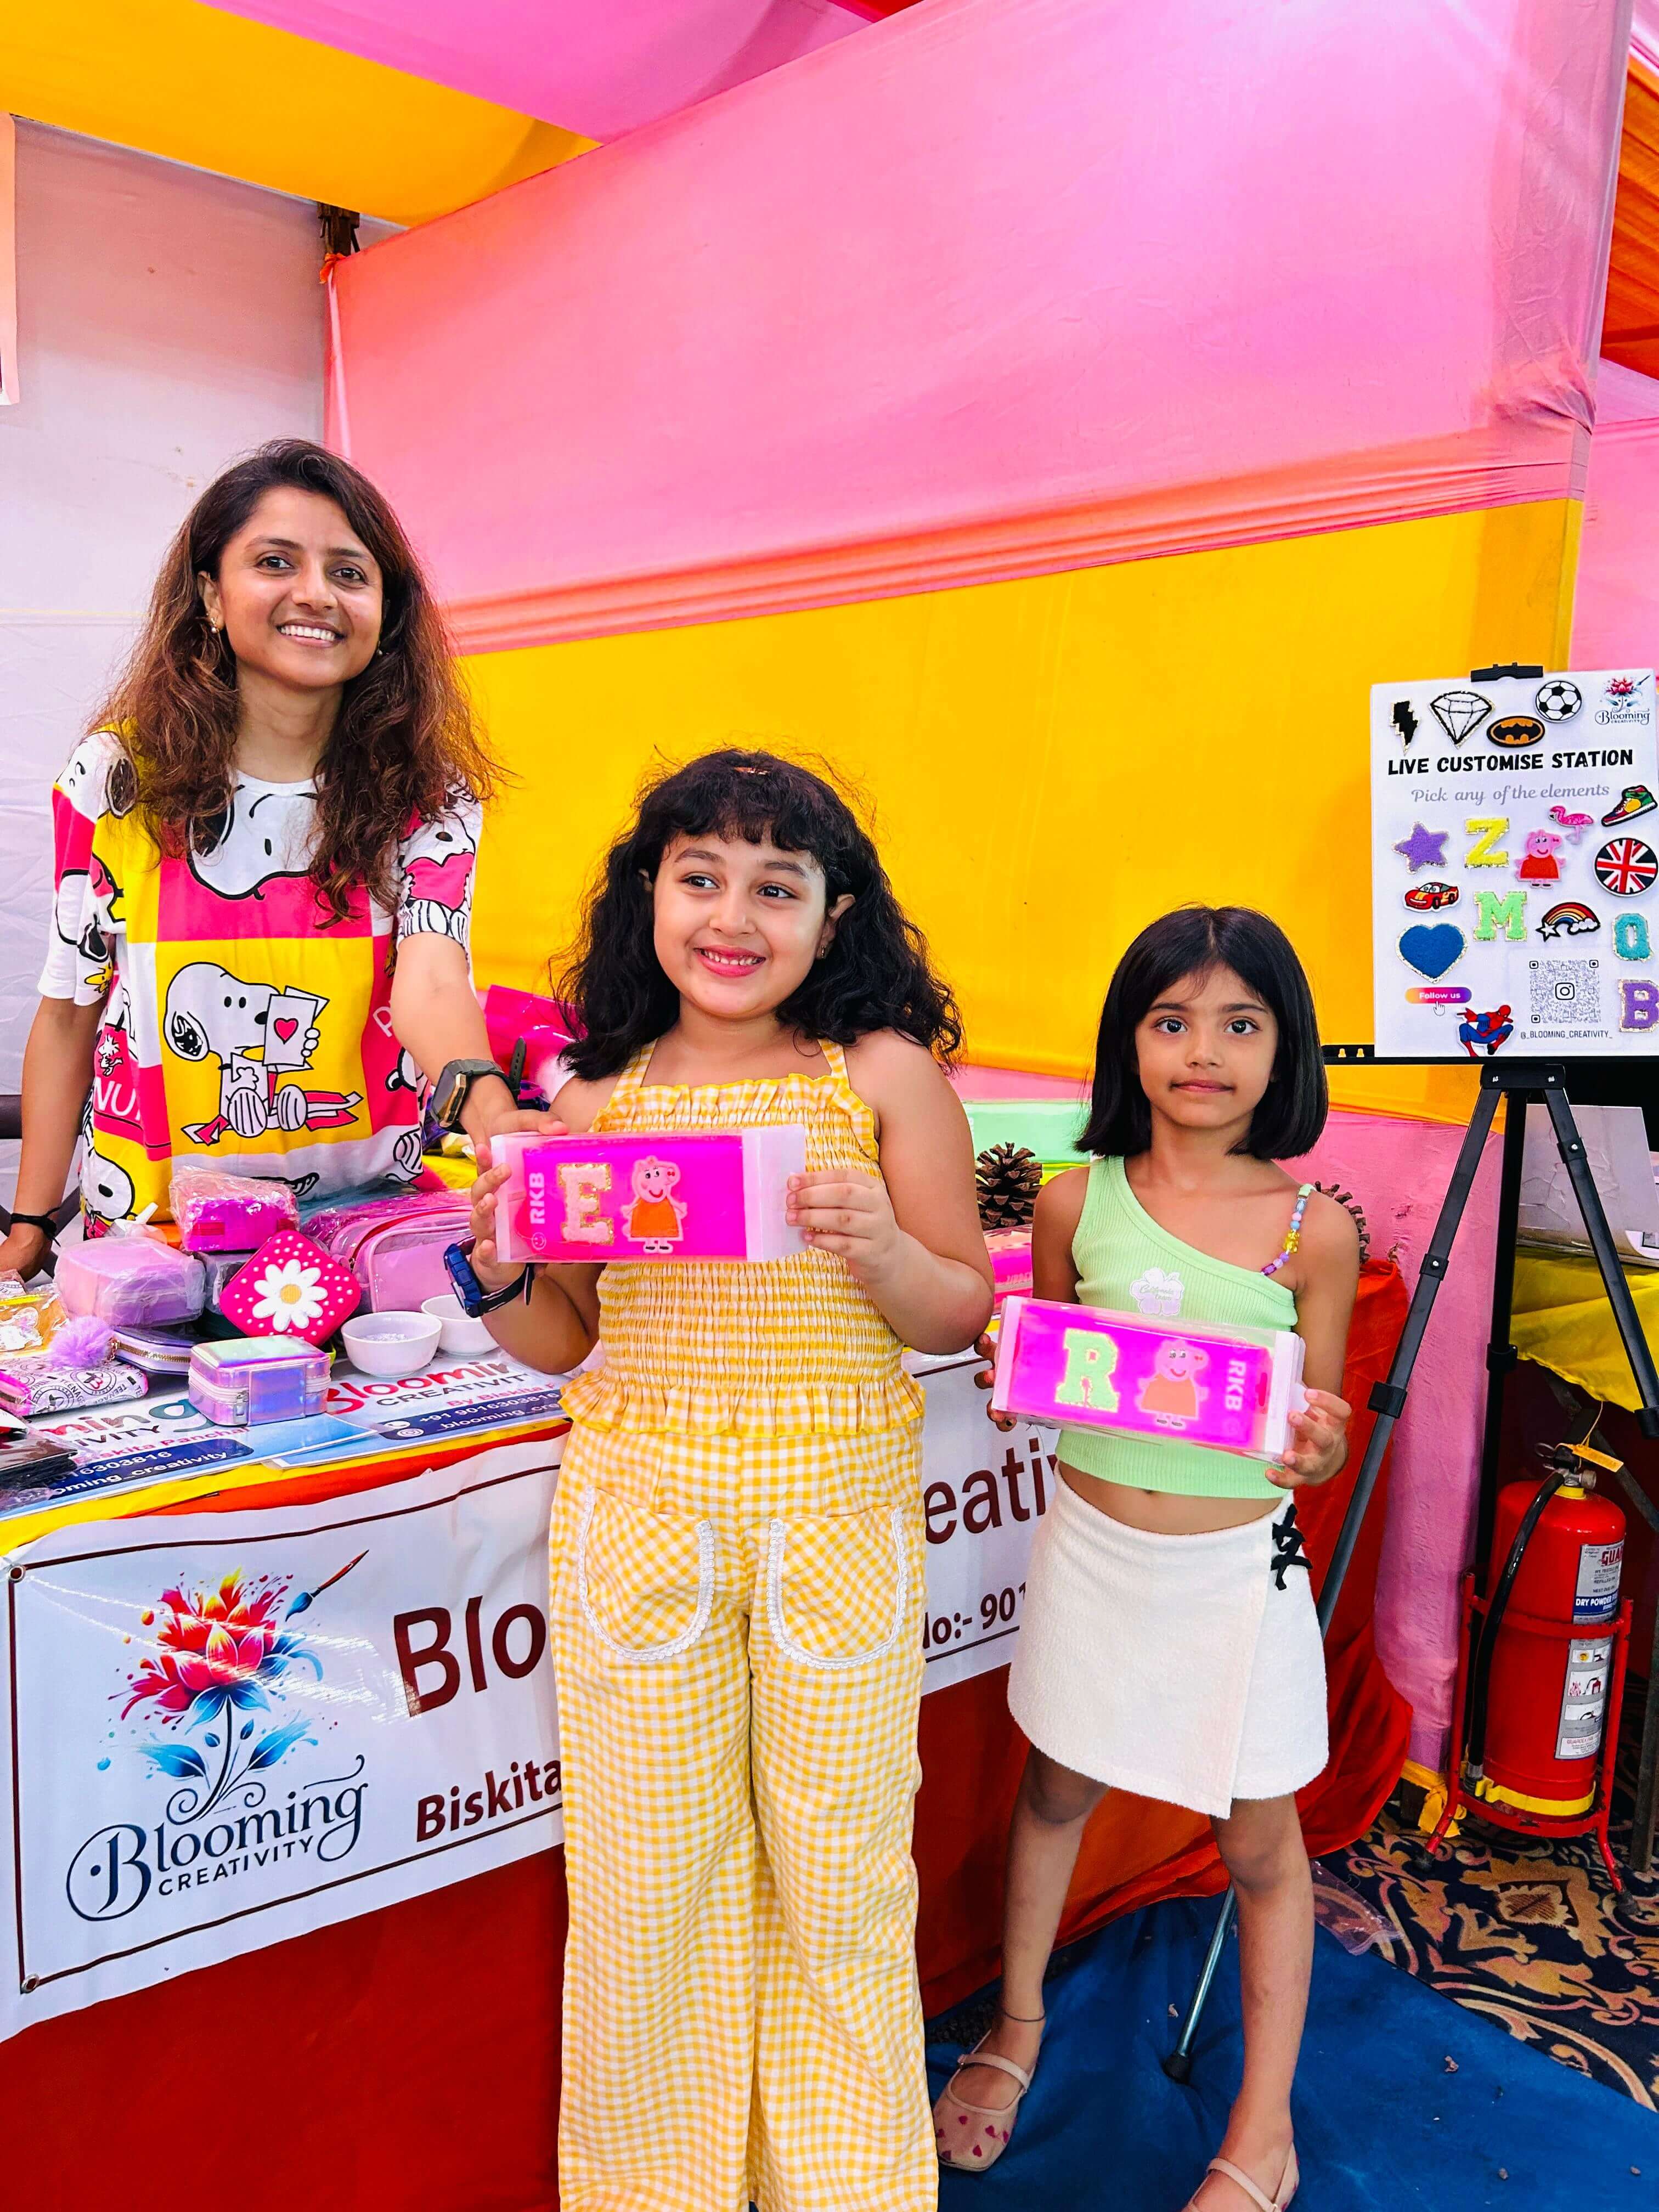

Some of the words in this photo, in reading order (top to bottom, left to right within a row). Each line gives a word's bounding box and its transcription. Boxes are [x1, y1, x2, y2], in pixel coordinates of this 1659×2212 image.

[1595, 708, 1650, 725] Blooming
[1388, 758, 1429, 775] LIVE
[1436, 753, 1544, 773] CUSTOMISE
[1552, 749, 1633, 768] STATION
[1411, 787, 1447, 803] Pick
[1454, 790, 1484, 806] any
[1493, 786, 1512, 805] of
[1511, 785, 1537, 799] the
[1540, 783, 1610, 798] elements
[1465, 818, 1509, 868] Z
[1474, 891, 1527, 942] M
[1618, 979, 1659, 1032] B
[528, 1172, 545, 1224] RKB
[556, 1163, 614, 1246] E
[1054, 1328, 1120, 1413] R
[1225, 1360, 1246, 1412] RKB
[419, 1412, 451, 1423] +91
[455, 1392, 560, 1417] 9016303816
[446, 1395, 474, 1408] By
[477, 1386, 542, 1402] Biskita
[1575, 1598, 1590, 1606] DRY
[1590, 1596, 1612, 1606] POWDER
[394, 1595, 548, 1718] Blo
[416, 1756, 563, 1843] Biskita
[66, 1754, 369, 1921] Blooming
[159, 1835, 314, 1897] CREATIVITY
